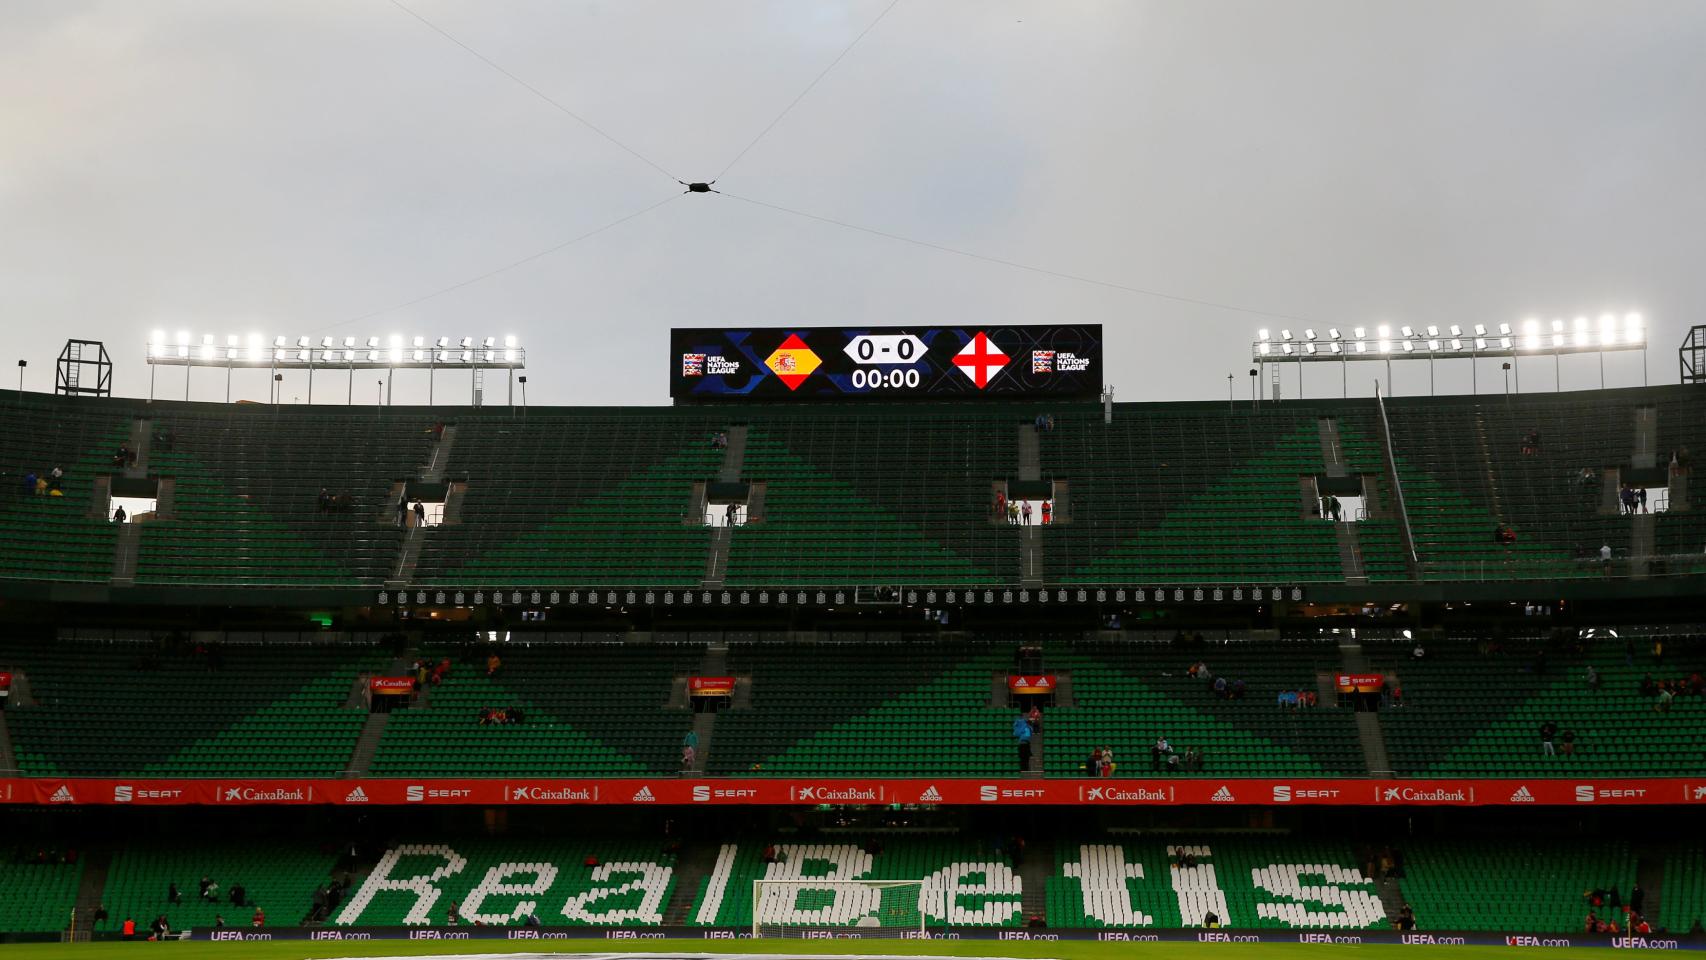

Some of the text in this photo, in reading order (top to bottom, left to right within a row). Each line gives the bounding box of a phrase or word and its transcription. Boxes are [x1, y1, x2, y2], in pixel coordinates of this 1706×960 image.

[858, 339, 874, 360] 0
[898, 338, 914, 360] 0
[852, 369, 920, 388] 00:00
[138, 790, 182, 798] SEAT
[243, 788, 304, 801] CaixaBank
[428, 790, 471, 798] SEAT
[530, 788, 590, 801] CaixaBank
[714, 790, 757, 798] SEAT
[816, 788, 876, 801] CaixaBank
[1002, 790, 1045, 798] SEAT
[1105, 788, 1166, 801] CaixaBank
[1295, 790, 1340, 798] SEAT
[1402, 788, 1465, 801] CaixaBank
[1599, 790, 1646, 798] SEAT
[335, 843, 1388, 930] Real Betis
[211, 931, 272, 940] UEFAcom
[311, 931, 371, 940] UEFAcom
[409, 930, 469, 940] UEFAcom
[508, 931, 568, 939] UEFAcom
[607, 931, 665, 939] UEFAcom
[704, 931, 763, 939] UEFAcom
[801, 931, 862, 939] UEFAcom
[998, 931, 1059, 941] UEFAcom
[1098, 932, 1159, 941] UEFAcom
[1198, 933, 1259, 942] UEFAcom
[1300, 933, 1362, 943] UEFAcom
[1402, 934, 1465, 945] UEFAcom
[1612, 937, 1677, 949] UEFA.com
